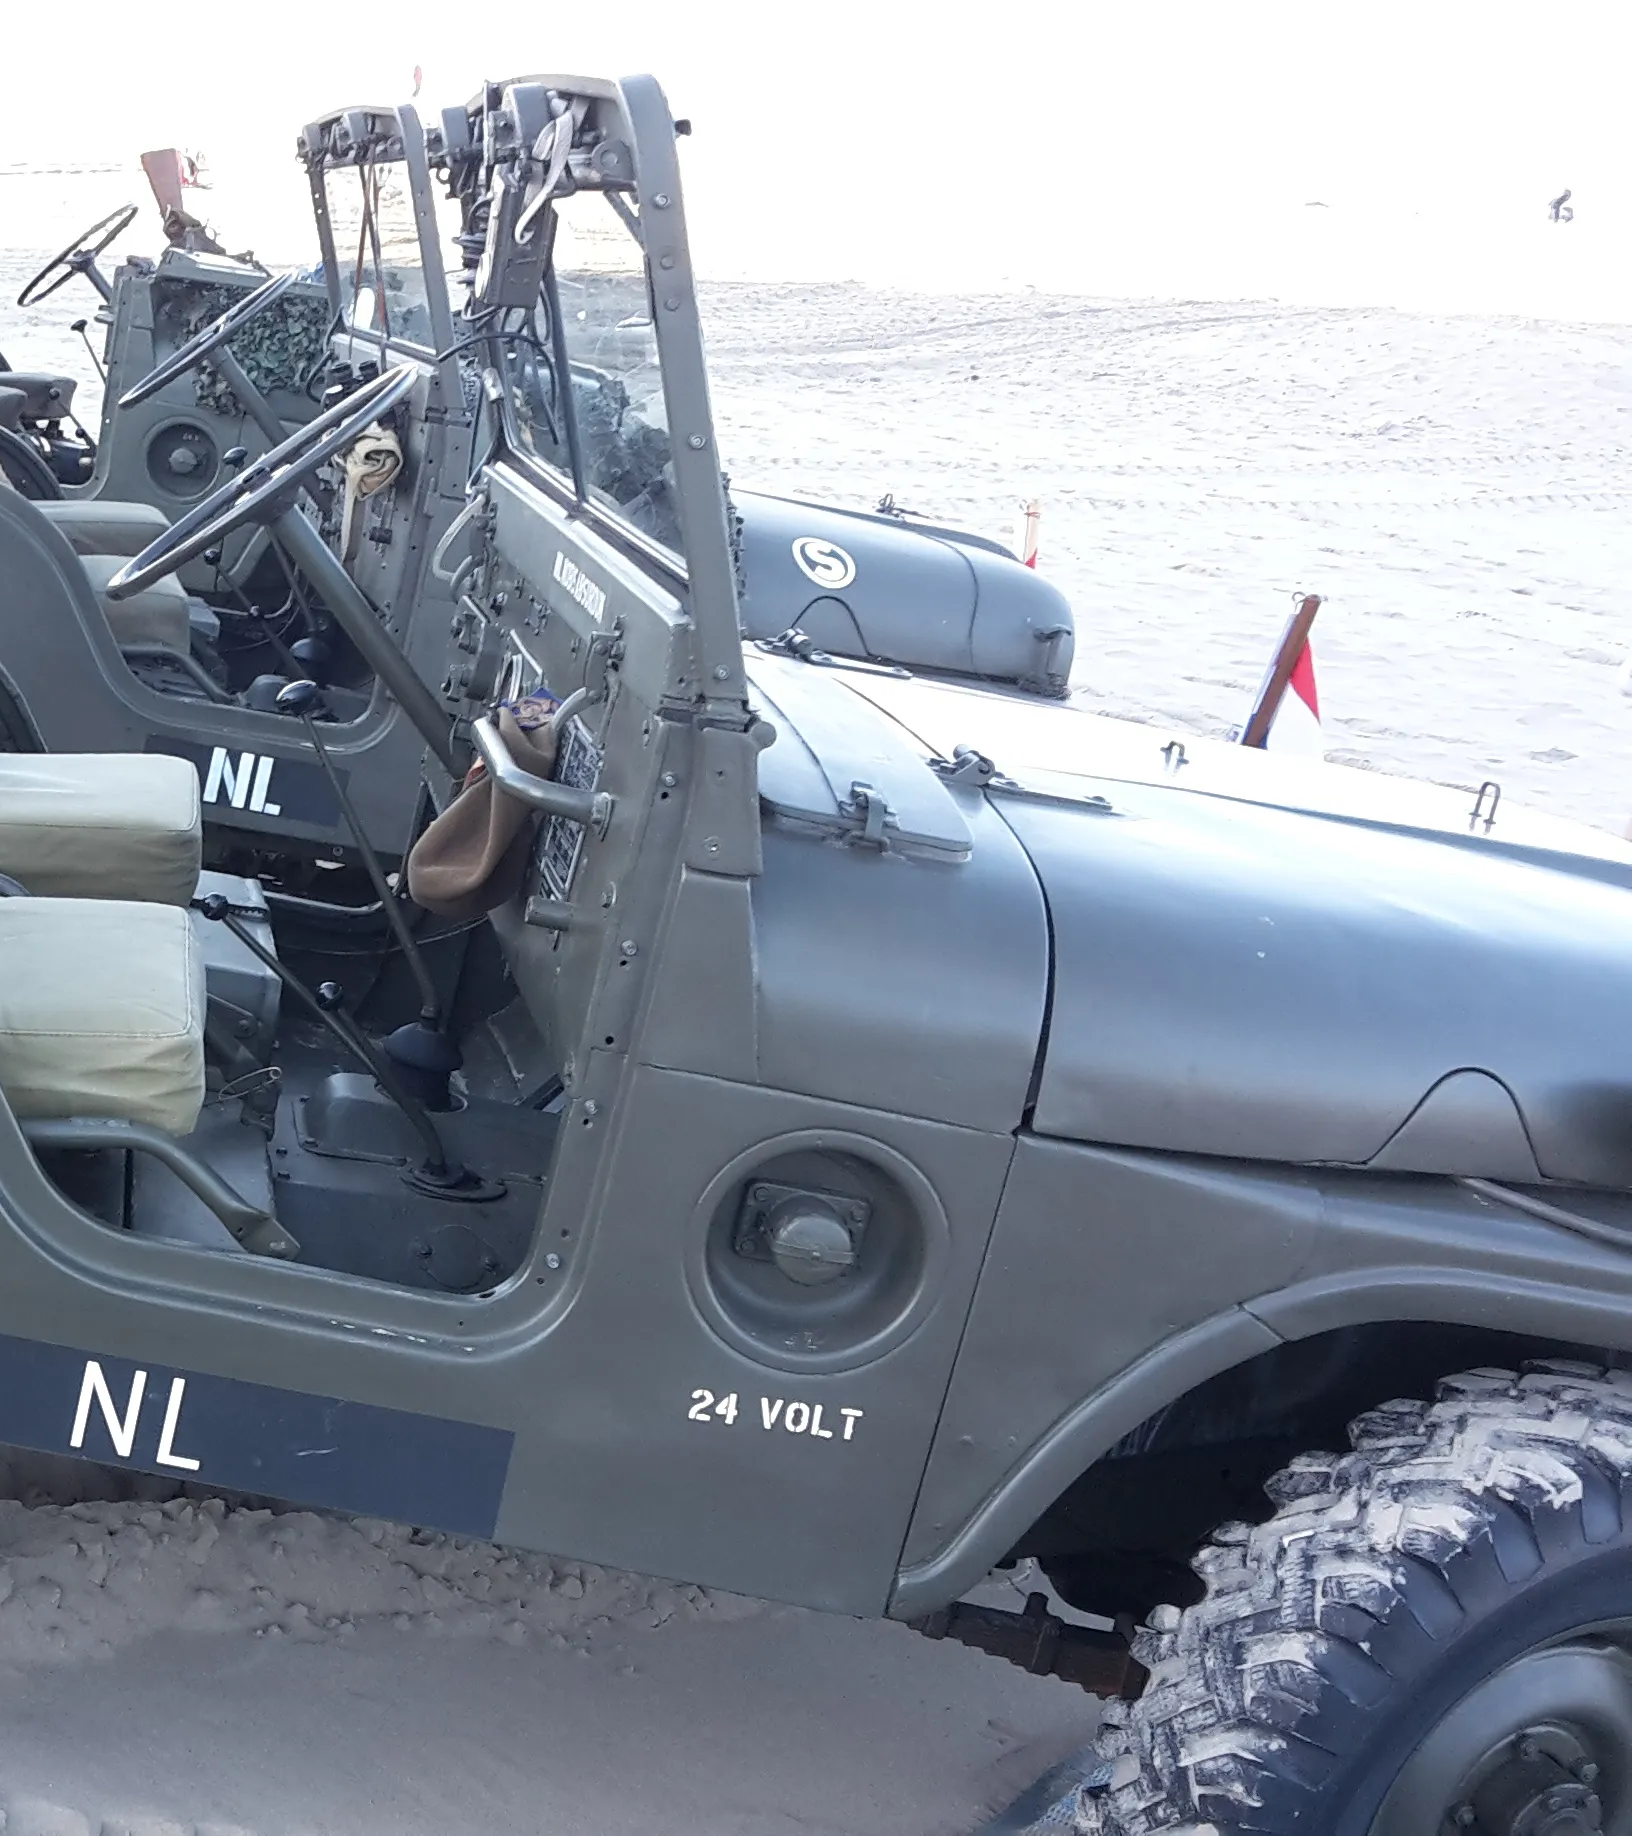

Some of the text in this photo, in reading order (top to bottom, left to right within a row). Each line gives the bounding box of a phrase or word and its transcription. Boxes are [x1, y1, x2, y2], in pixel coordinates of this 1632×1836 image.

[203, 746, 281, 816] NL
[70, 1360, 201, 1471] NL
[688, 1389, 864, 1440] 24 VOLT
